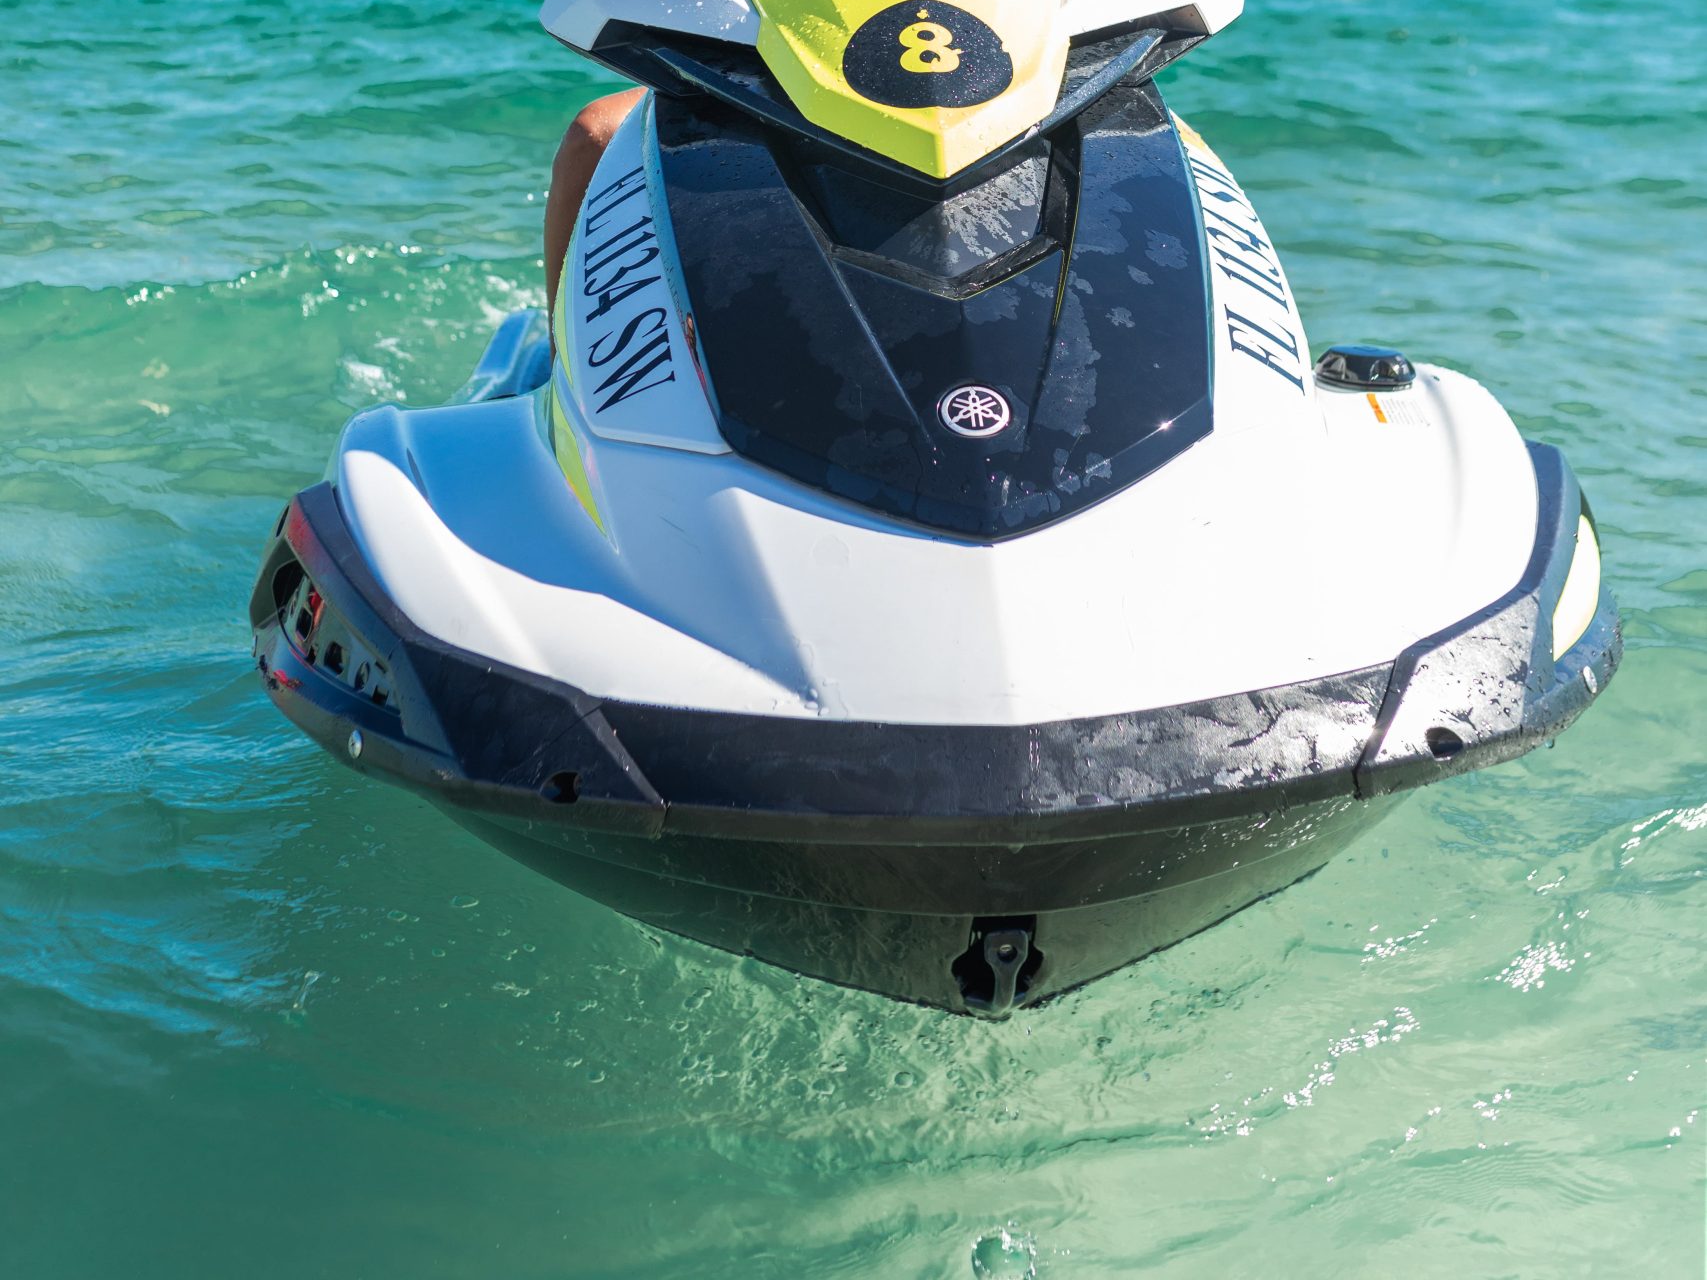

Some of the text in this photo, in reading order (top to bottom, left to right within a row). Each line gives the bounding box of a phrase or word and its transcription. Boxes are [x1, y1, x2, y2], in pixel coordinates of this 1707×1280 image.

[898, 21, 960, 74] 8
[583, 165, 676, 414] FL 1134 SW
[1202, 206, 1291, 315] 1134
[1223, 302, 1306, 397] FL
